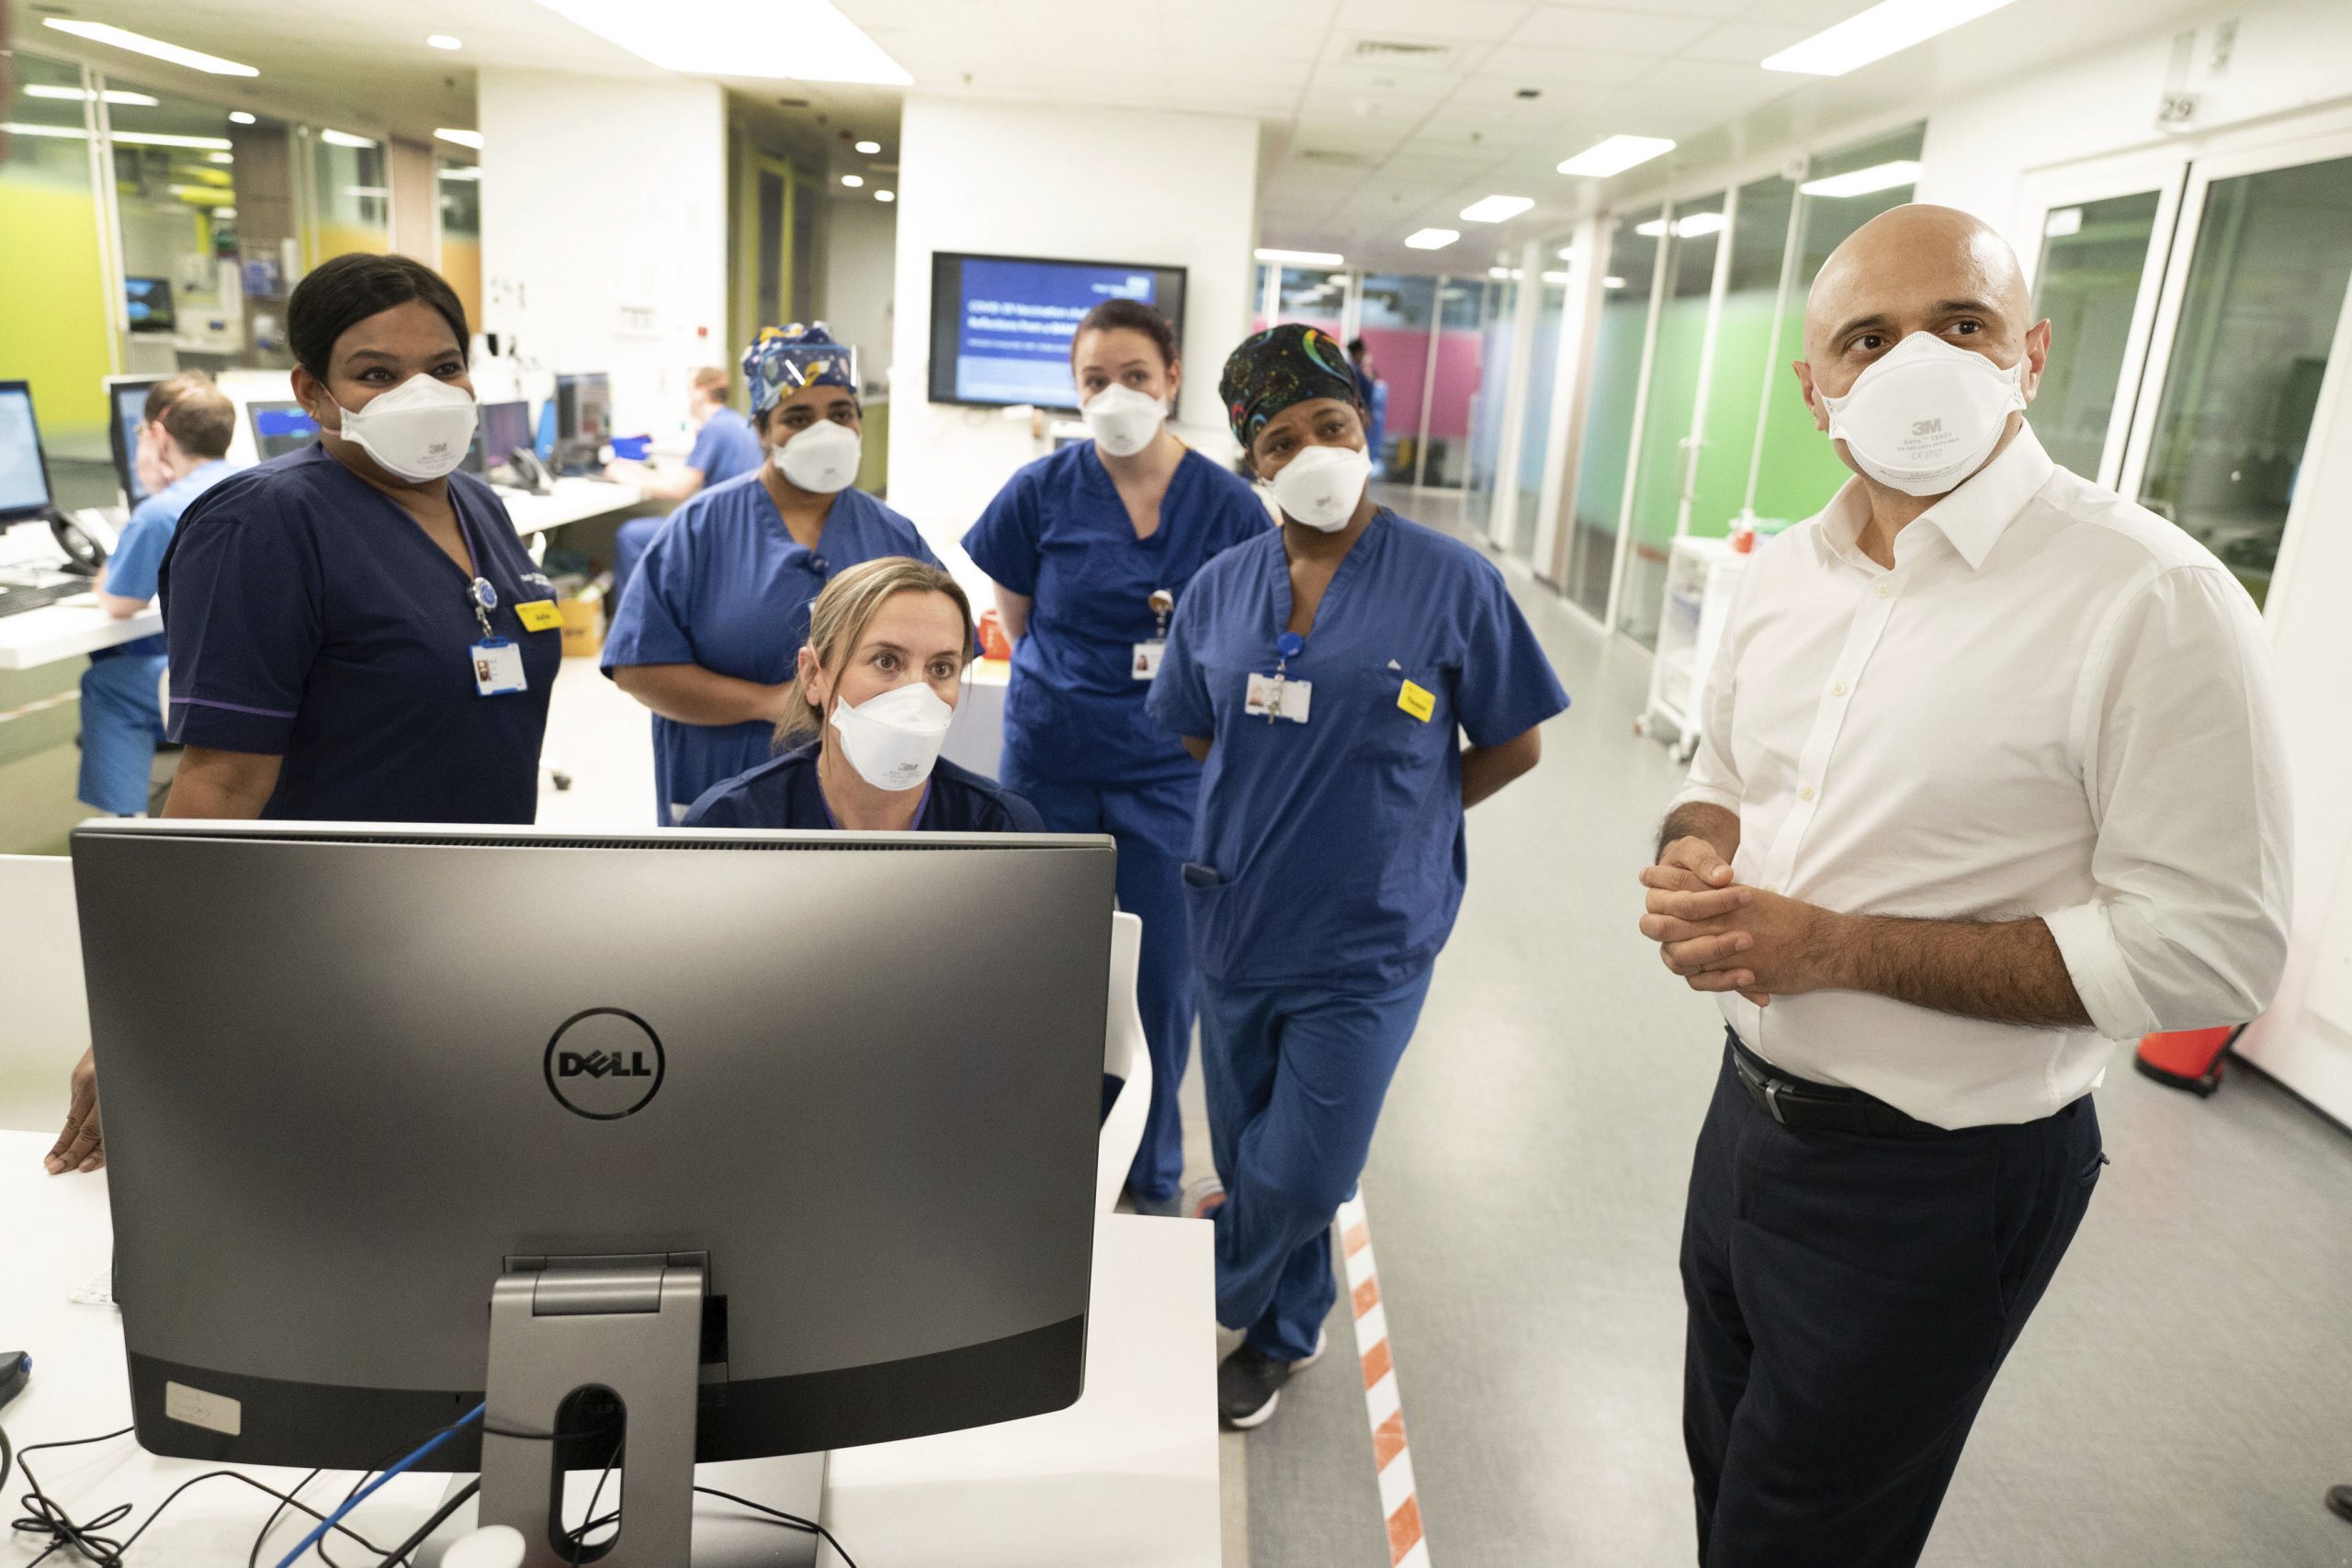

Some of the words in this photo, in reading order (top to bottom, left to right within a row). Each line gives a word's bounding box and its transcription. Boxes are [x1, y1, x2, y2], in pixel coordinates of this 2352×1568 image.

[2160, 97, 2193, 121] 29
[1912, 417, 1942, 435] 3M
[428, 443, 447, 455] 3M
[559, 1050, 651, 1078] DELL
